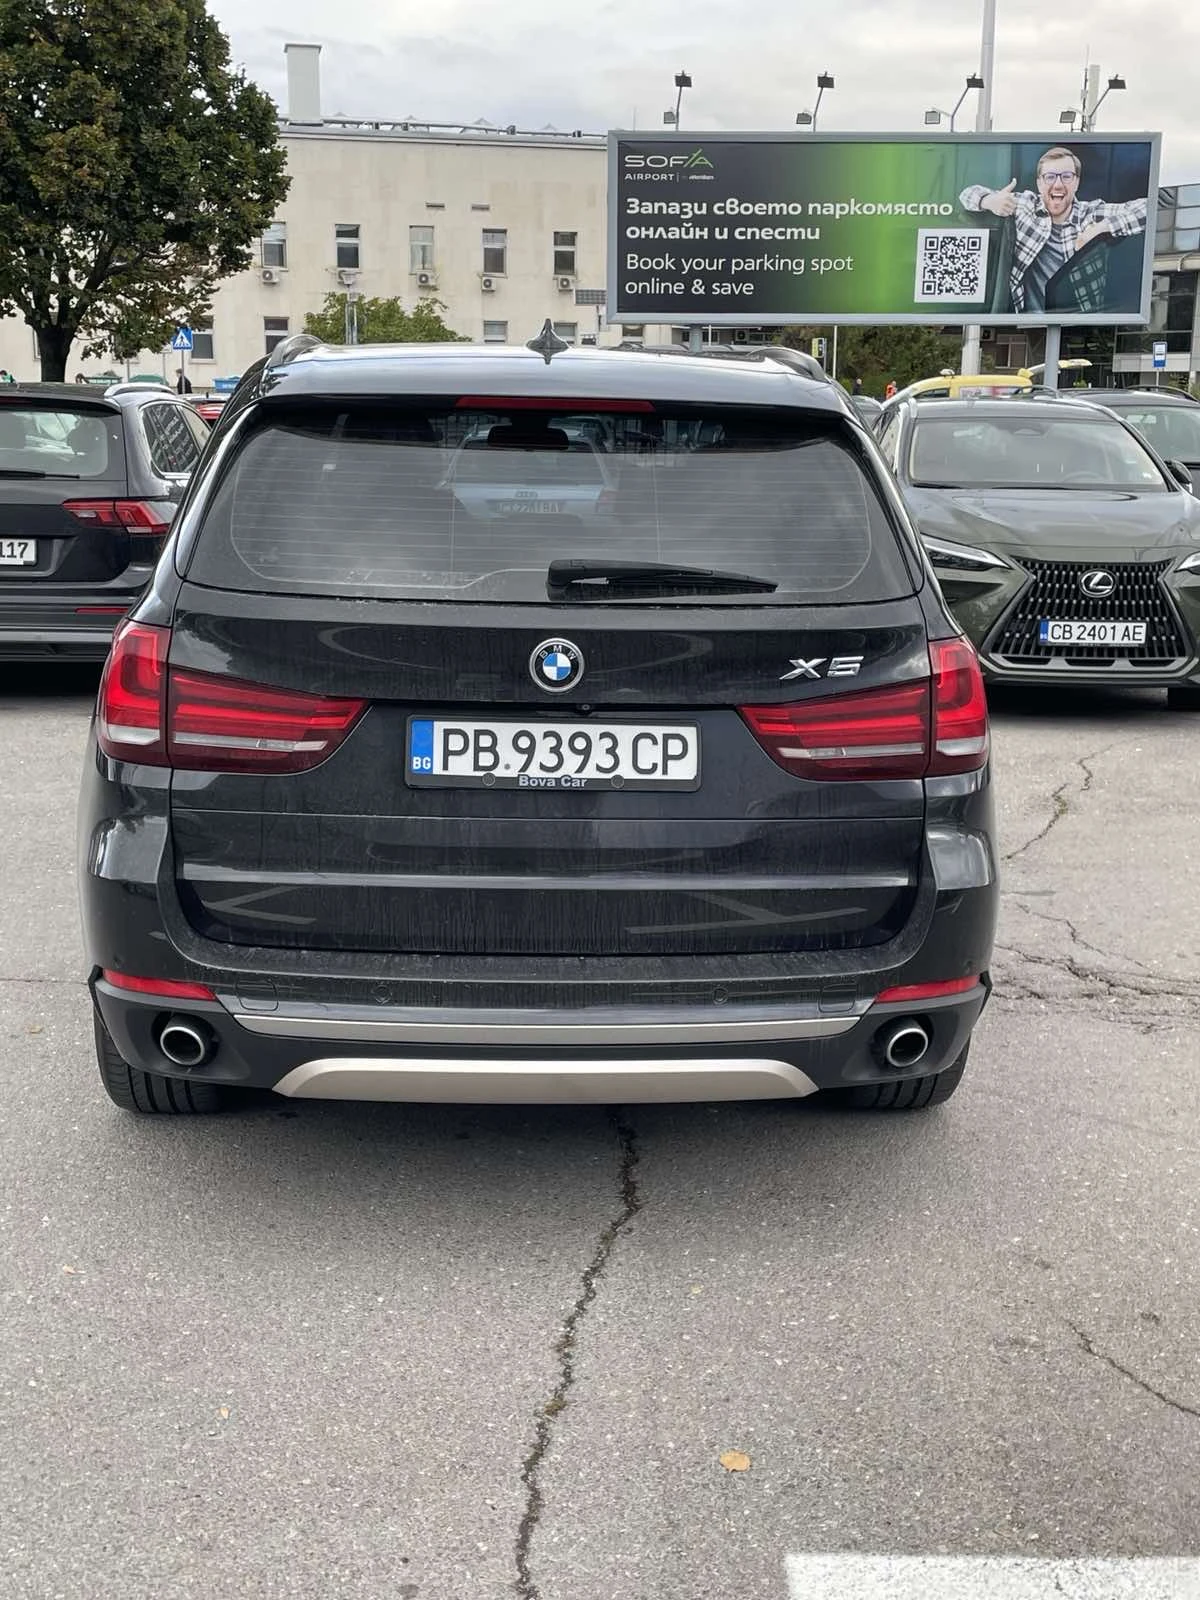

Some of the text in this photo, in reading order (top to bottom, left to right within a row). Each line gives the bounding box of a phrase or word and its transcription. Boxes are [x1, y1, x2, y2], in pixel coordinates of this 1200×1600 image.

[624, 148, 714, 169] SOFIA
[624, 173, 675, 181] AIRPORT
[626, 197, 954, 219] Запази своето паркомясто
[625, 222, 820, 240] онлайн и спести
[626, 253, 854, 275] Book your parking spot
[625, 277, 755, 295] online & save
[1051, 624, 1073, 641] CB
[1076, 624, 1117, 641] 2401
[1121, 625, 1144, 641] AE
[539, 644, 577, 661] BMW
[779, 655, 864, 680] X5
[442, 728, 689, 776] PB 9393 CP
[412, 756, 432, 770] BG
[518, 775, 588, 788] Bova Car
